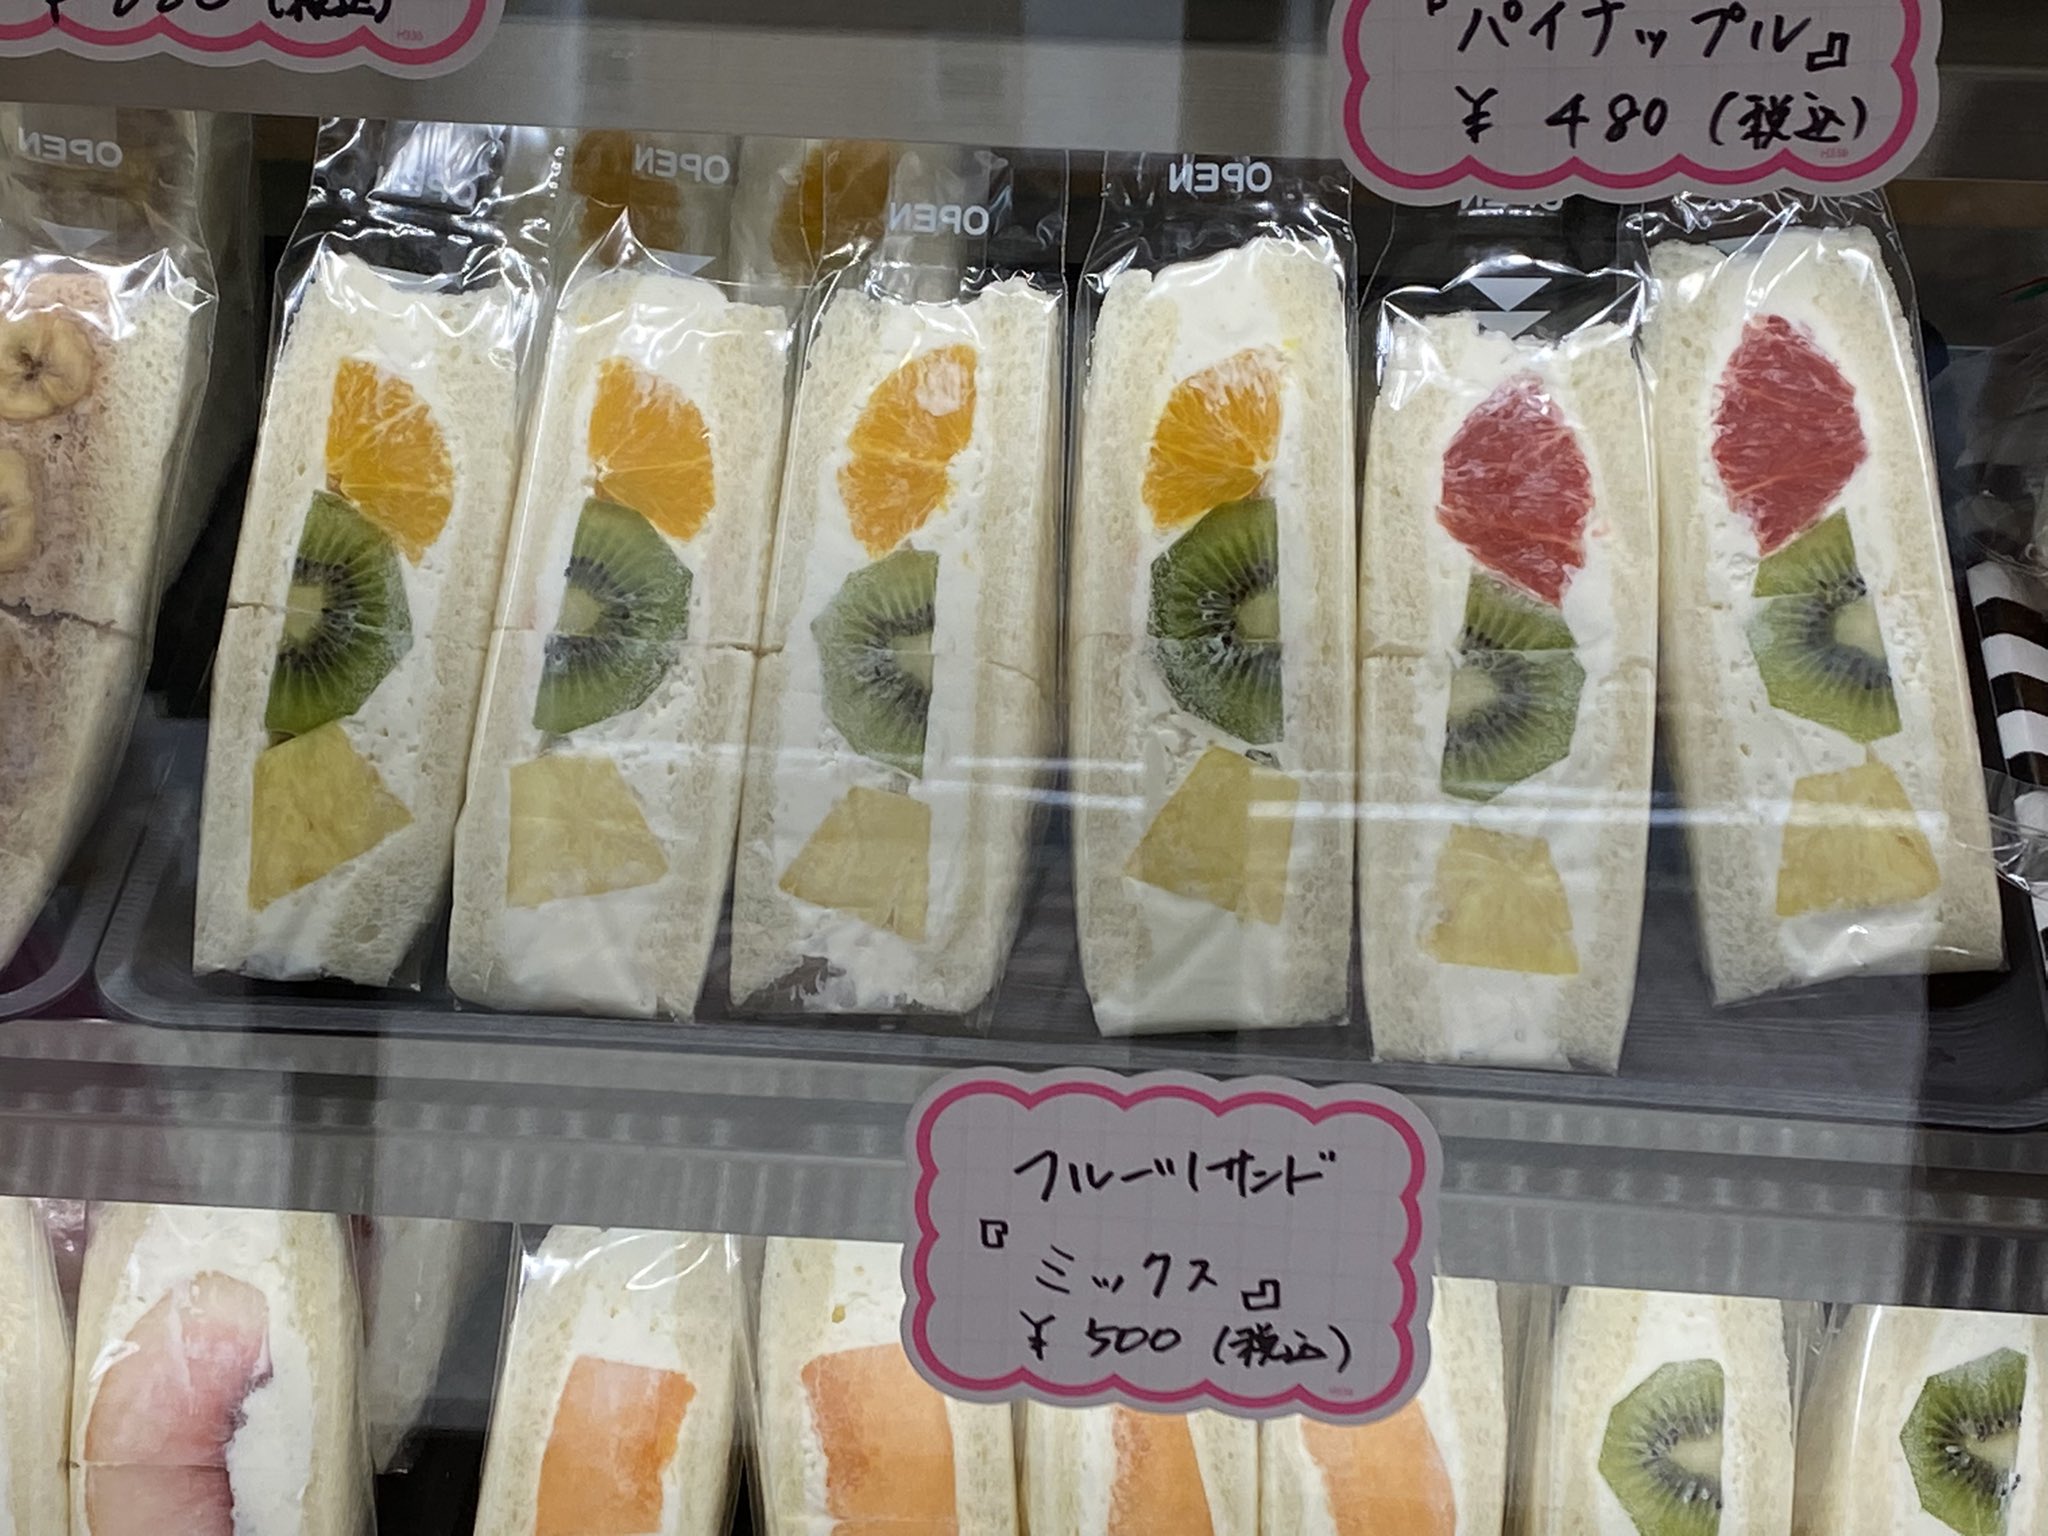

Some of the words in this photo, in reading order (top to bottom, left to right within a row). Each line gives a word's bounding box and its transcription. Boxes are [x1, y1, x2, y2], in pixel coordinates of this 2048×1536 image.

[1455, 86, 1498, 144] ¥
[1545, 94, 1668, 148] 480
[1709, 91, 1867, 150] (税込)
[1014, 1150, 1335, 1201] フルーツサンド
[1020, 1311, 1055, 1360] ¥
[1086, 1318, 1181, 1357] 500
[1214, 1323, 1350, 1372] (税込)
